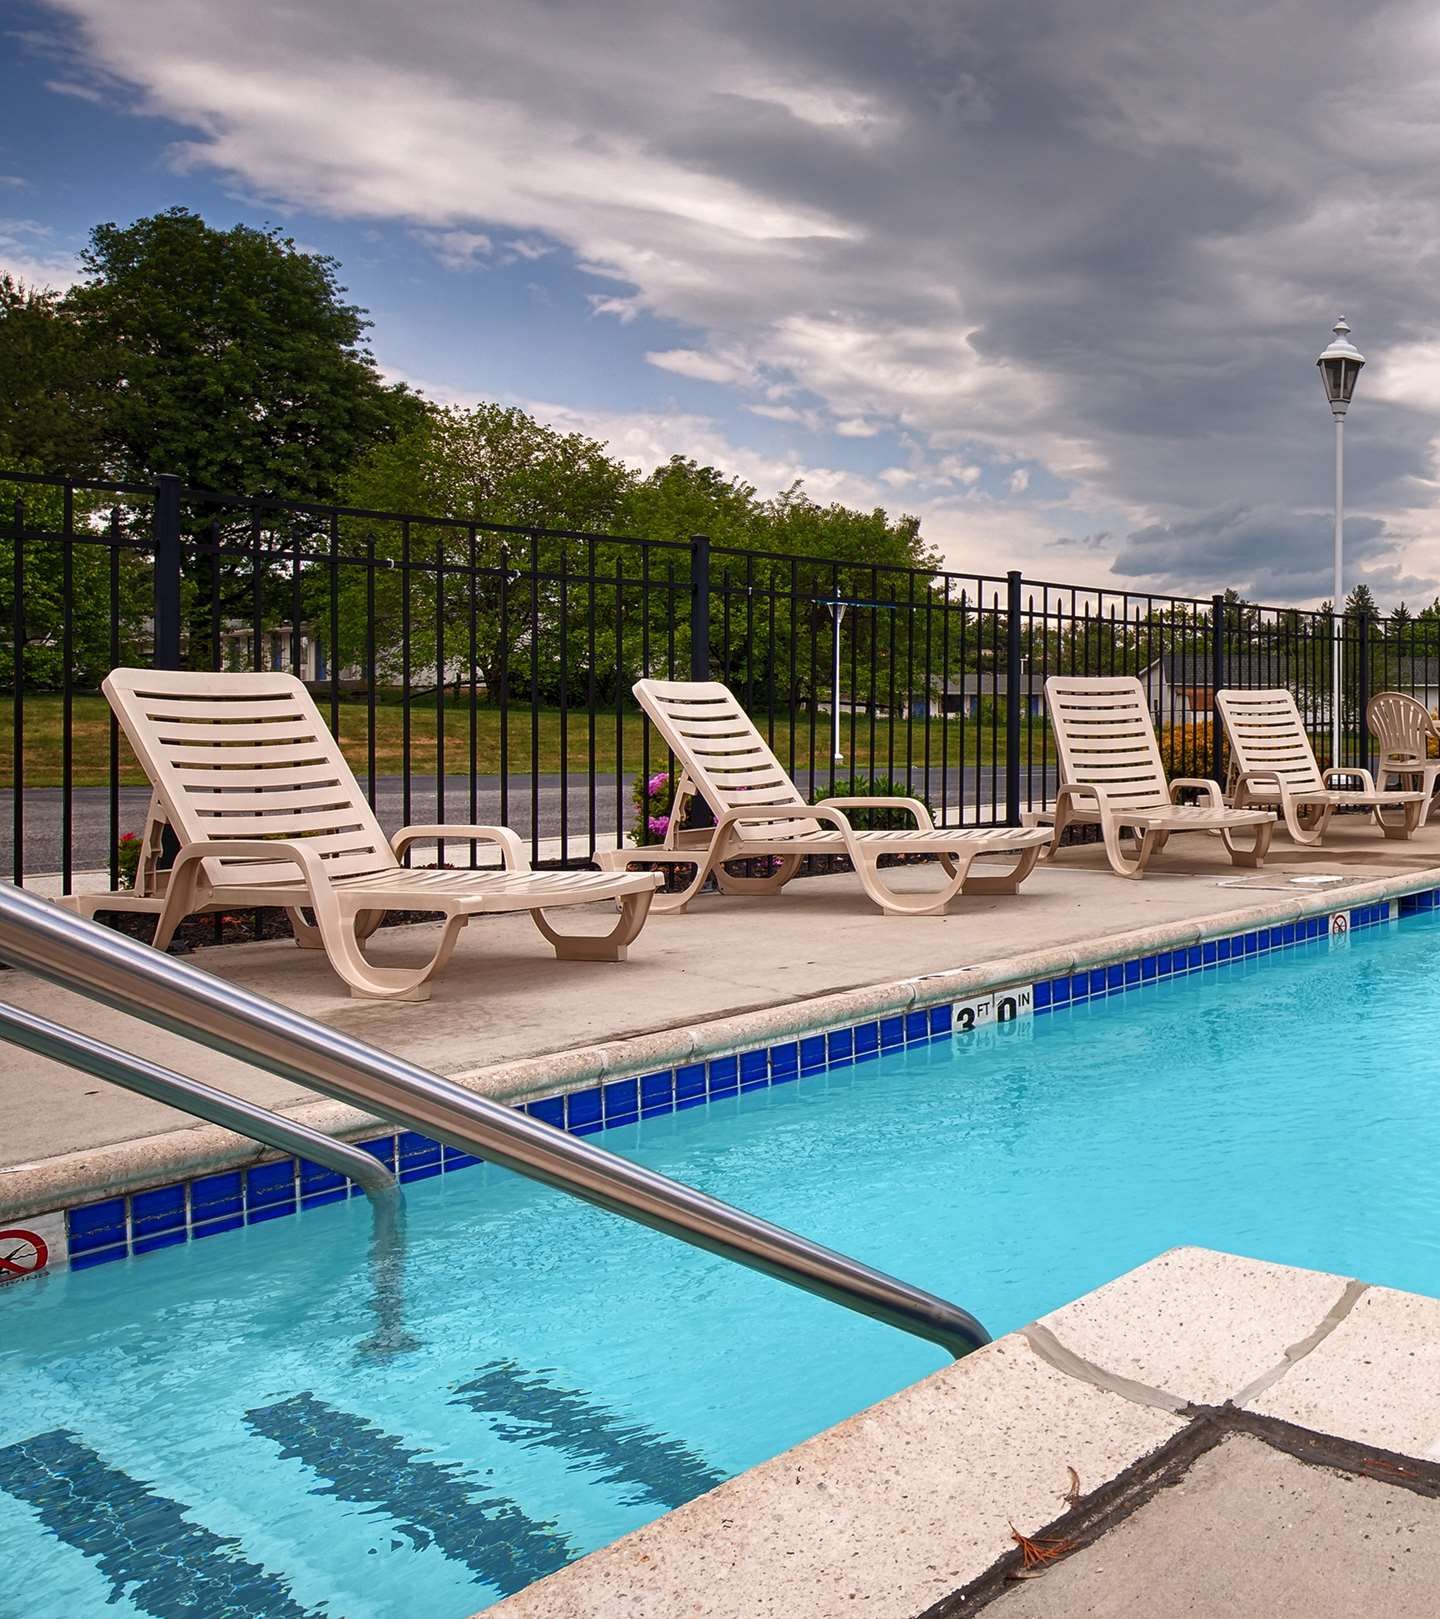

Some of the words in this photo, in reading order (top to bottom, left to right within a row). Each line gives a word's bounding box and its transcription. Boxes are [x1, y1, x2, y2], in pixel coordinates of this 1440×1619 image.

[956, 1007, 977, 1034] 3
[977, 1002, 990, 1018] FT
[997, 996, 1017, 1024] 0
[1017, 992, 1031, 1007] IN
